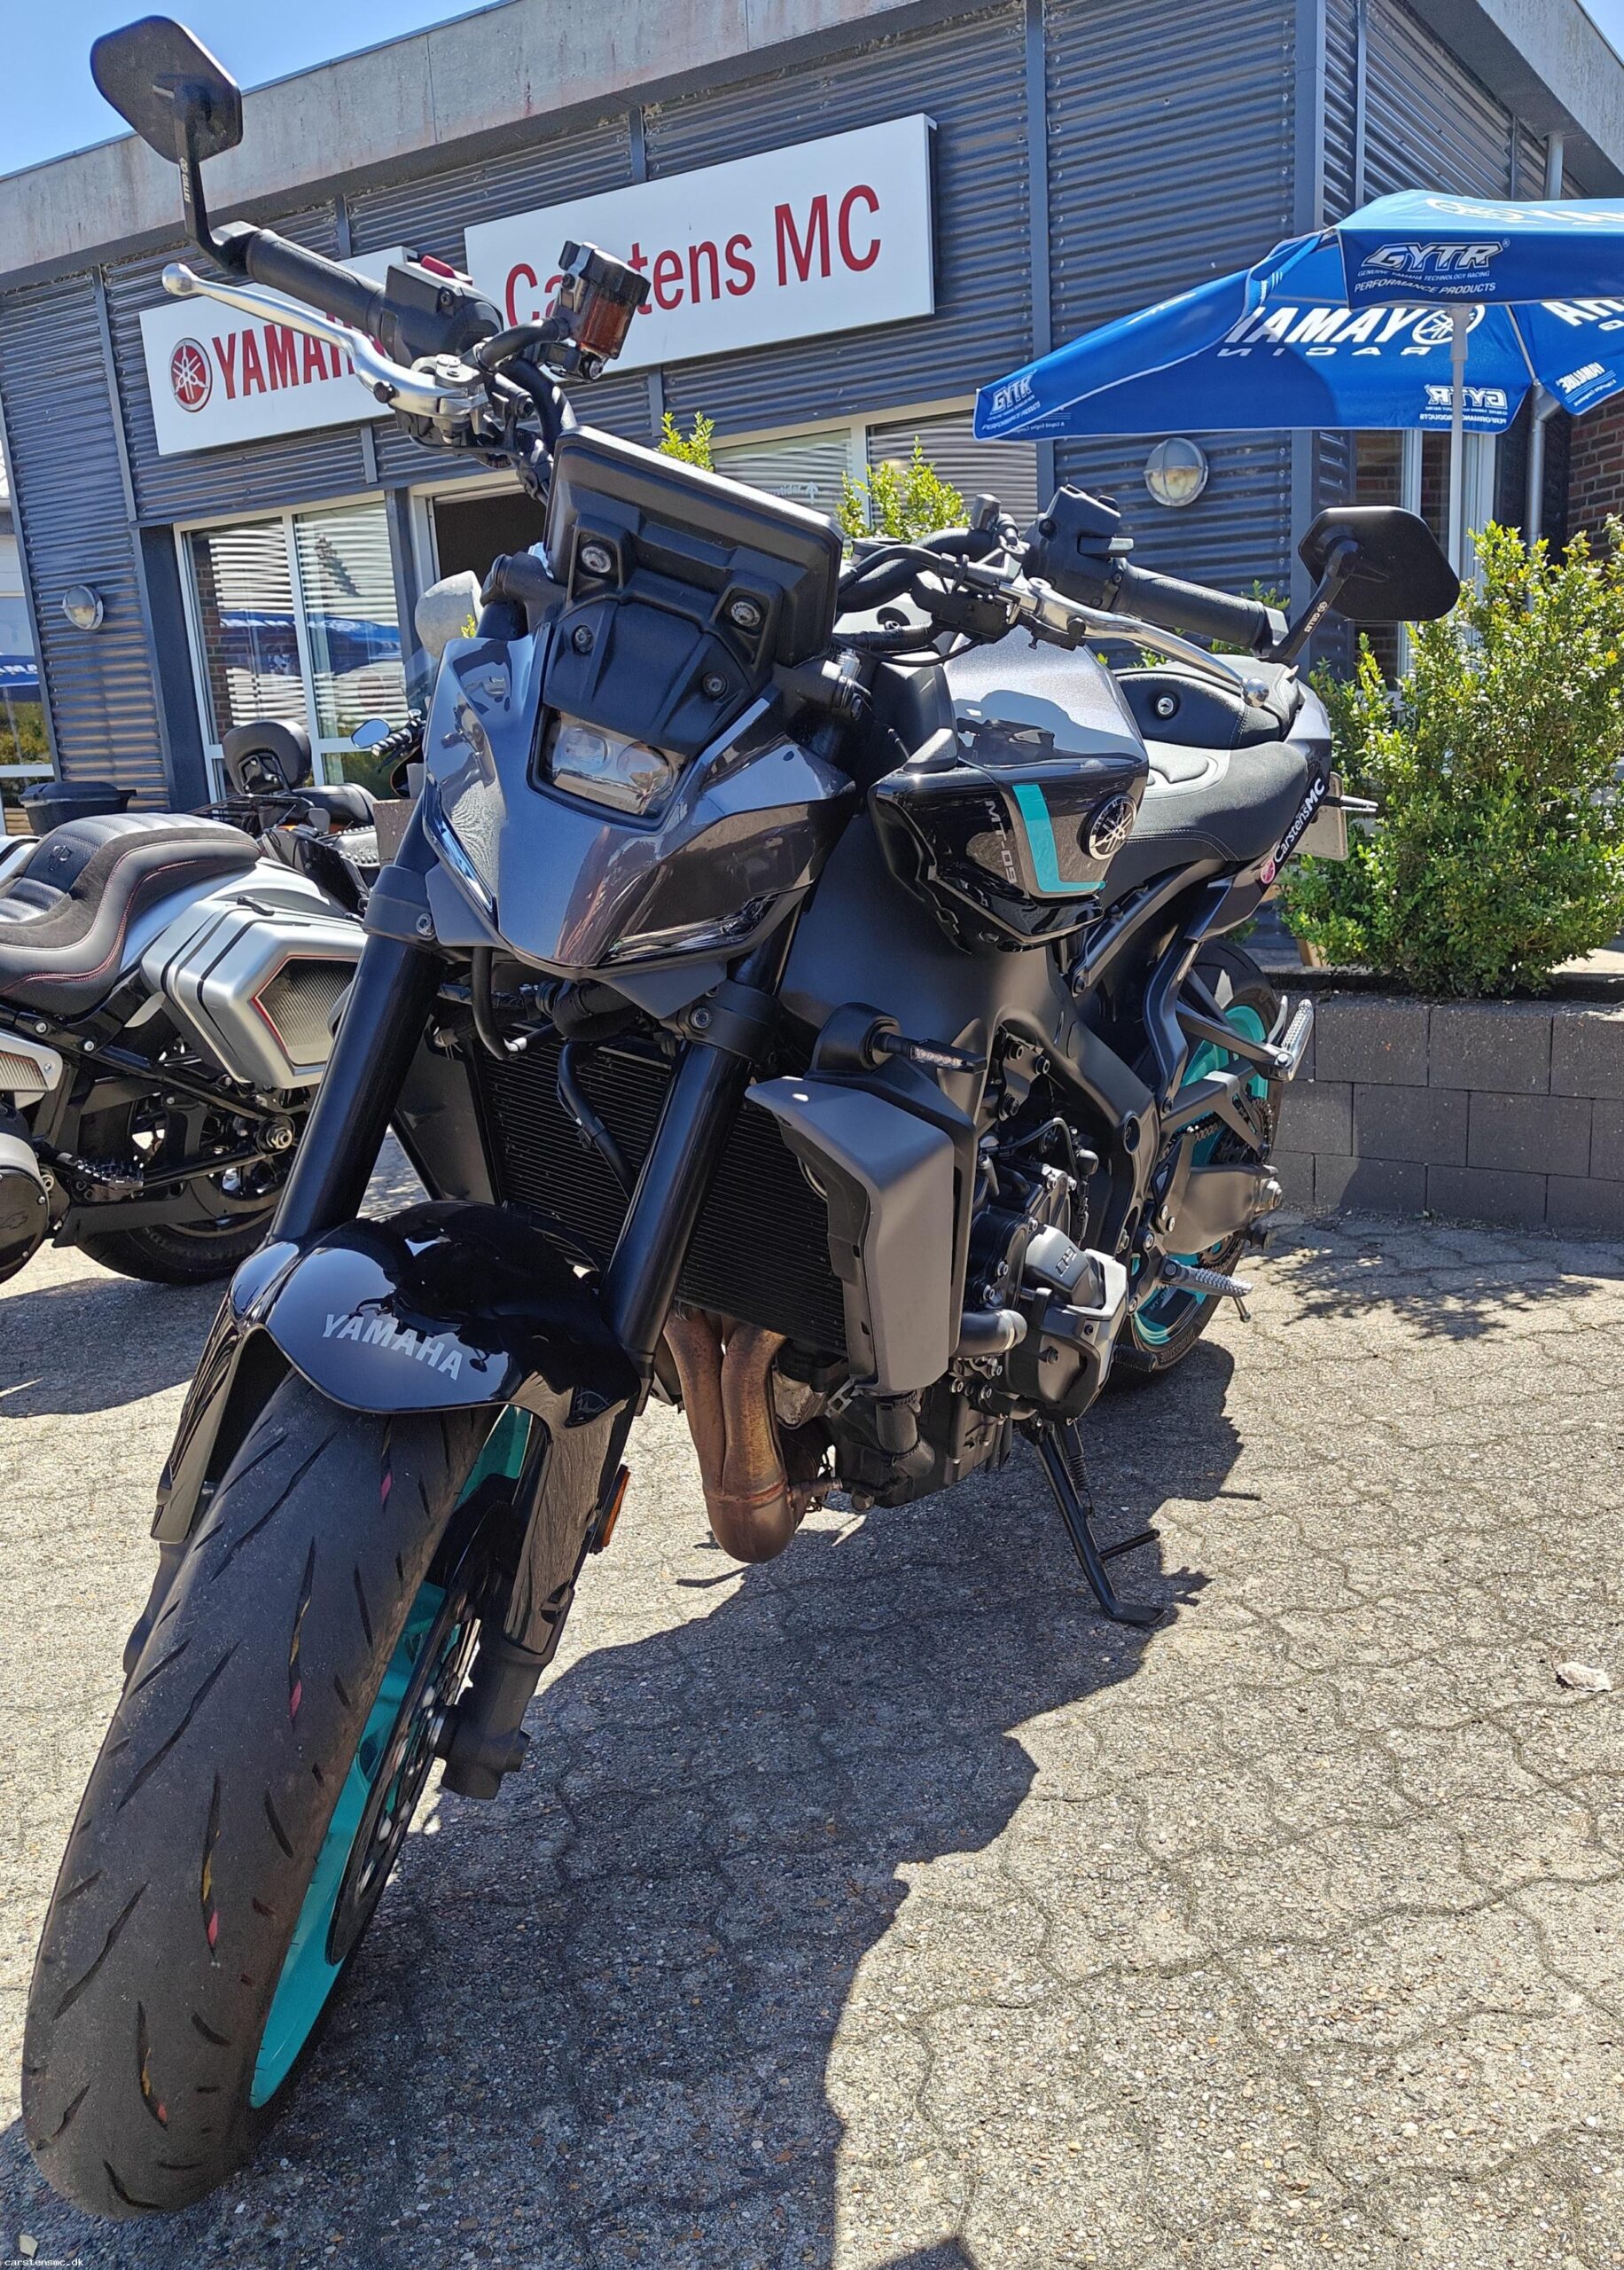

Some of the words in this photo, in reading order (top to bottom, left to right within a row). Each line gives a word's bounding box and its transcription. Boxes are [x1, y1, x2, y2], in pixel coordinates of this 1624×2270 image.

[505, 233, 756, 327] Ctens
[774, 184, 881, 286] MC
[1355, 278, 1438, 294] PERFORMANCE
[1438, 282, 1496, 294] PRODUCTS
[1362, 242, 1503, 271] GYTR
[212, 313, 386, 399] YAMAH
[989, 372, 1033, 415] GYTR
[984, 801, 1018, 884] MT-09
[322, 1314, 463, 1381] YAMAHA
